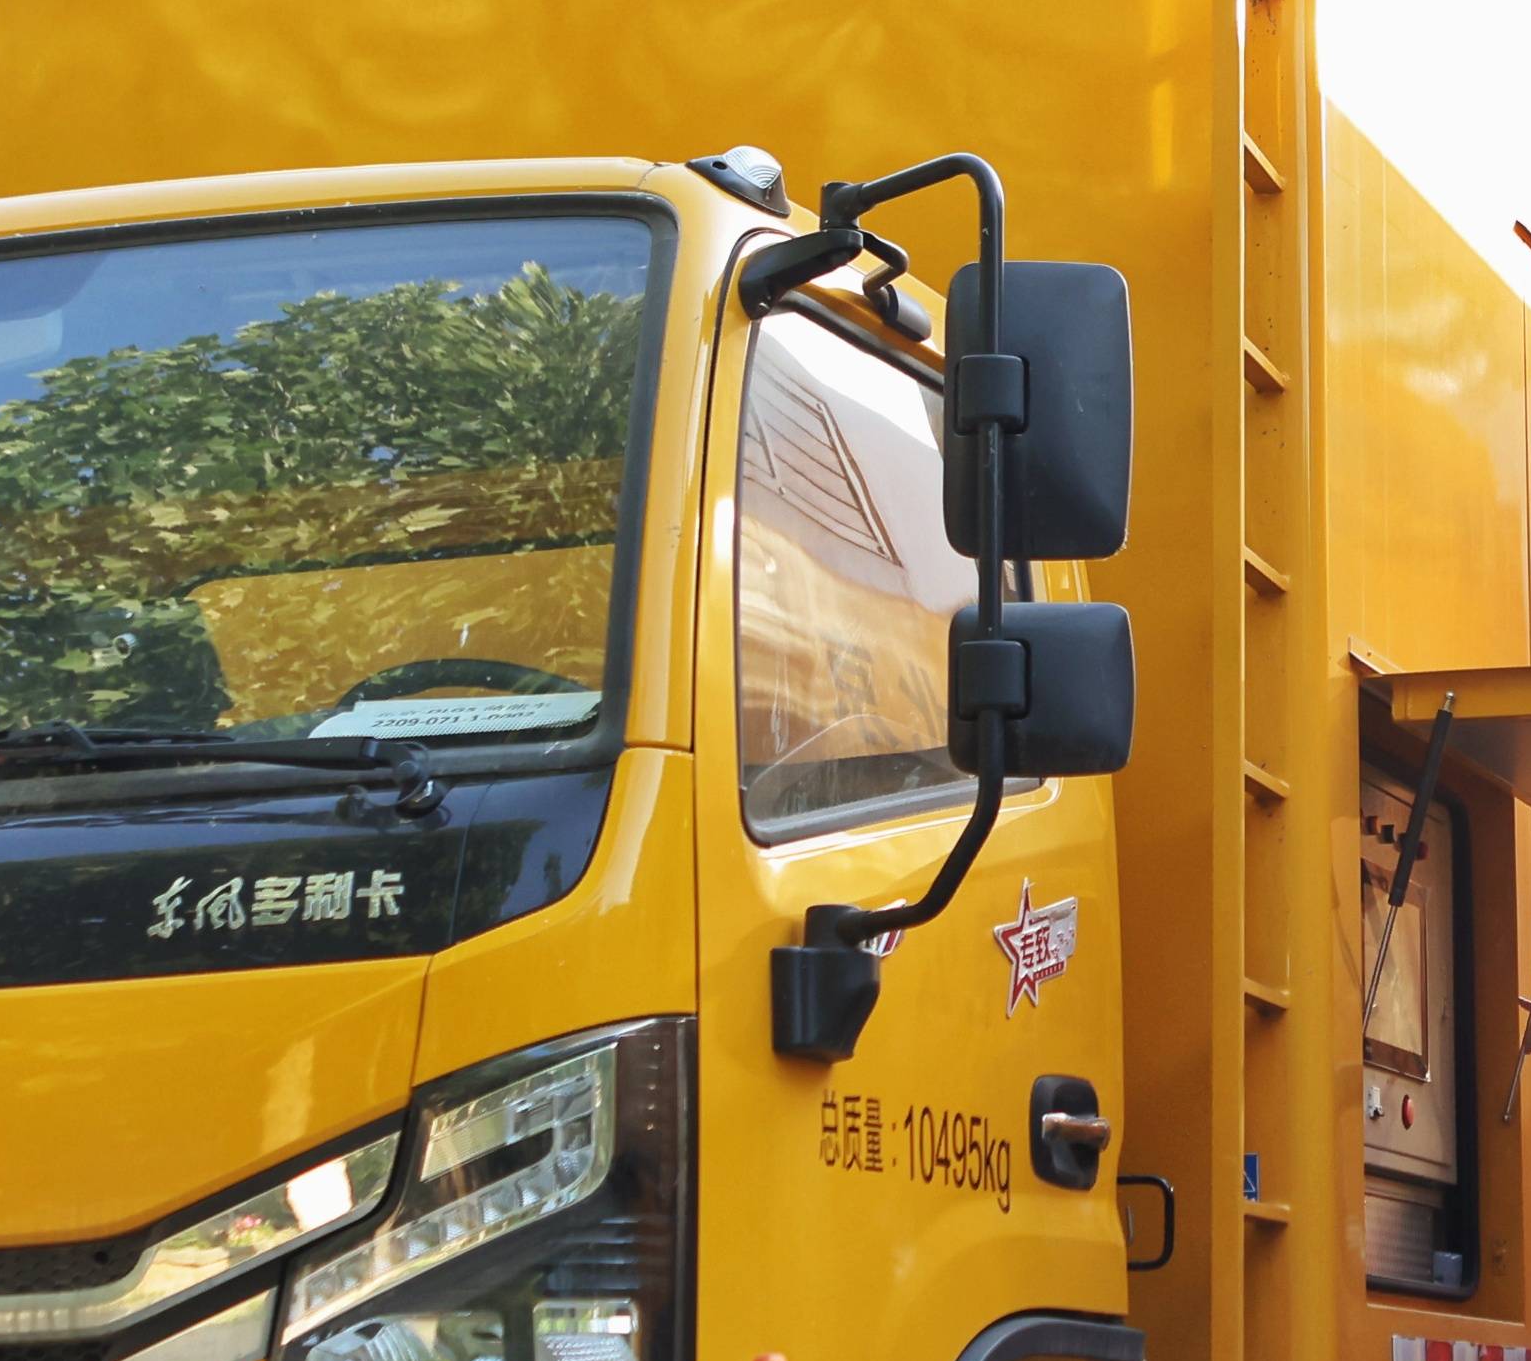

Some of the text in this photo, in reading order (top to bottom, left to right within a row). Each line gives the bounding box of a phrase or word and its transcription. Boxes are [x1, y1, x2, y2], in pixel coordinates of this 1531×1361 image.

[147, 869, 405, 939] 东风多利卡
